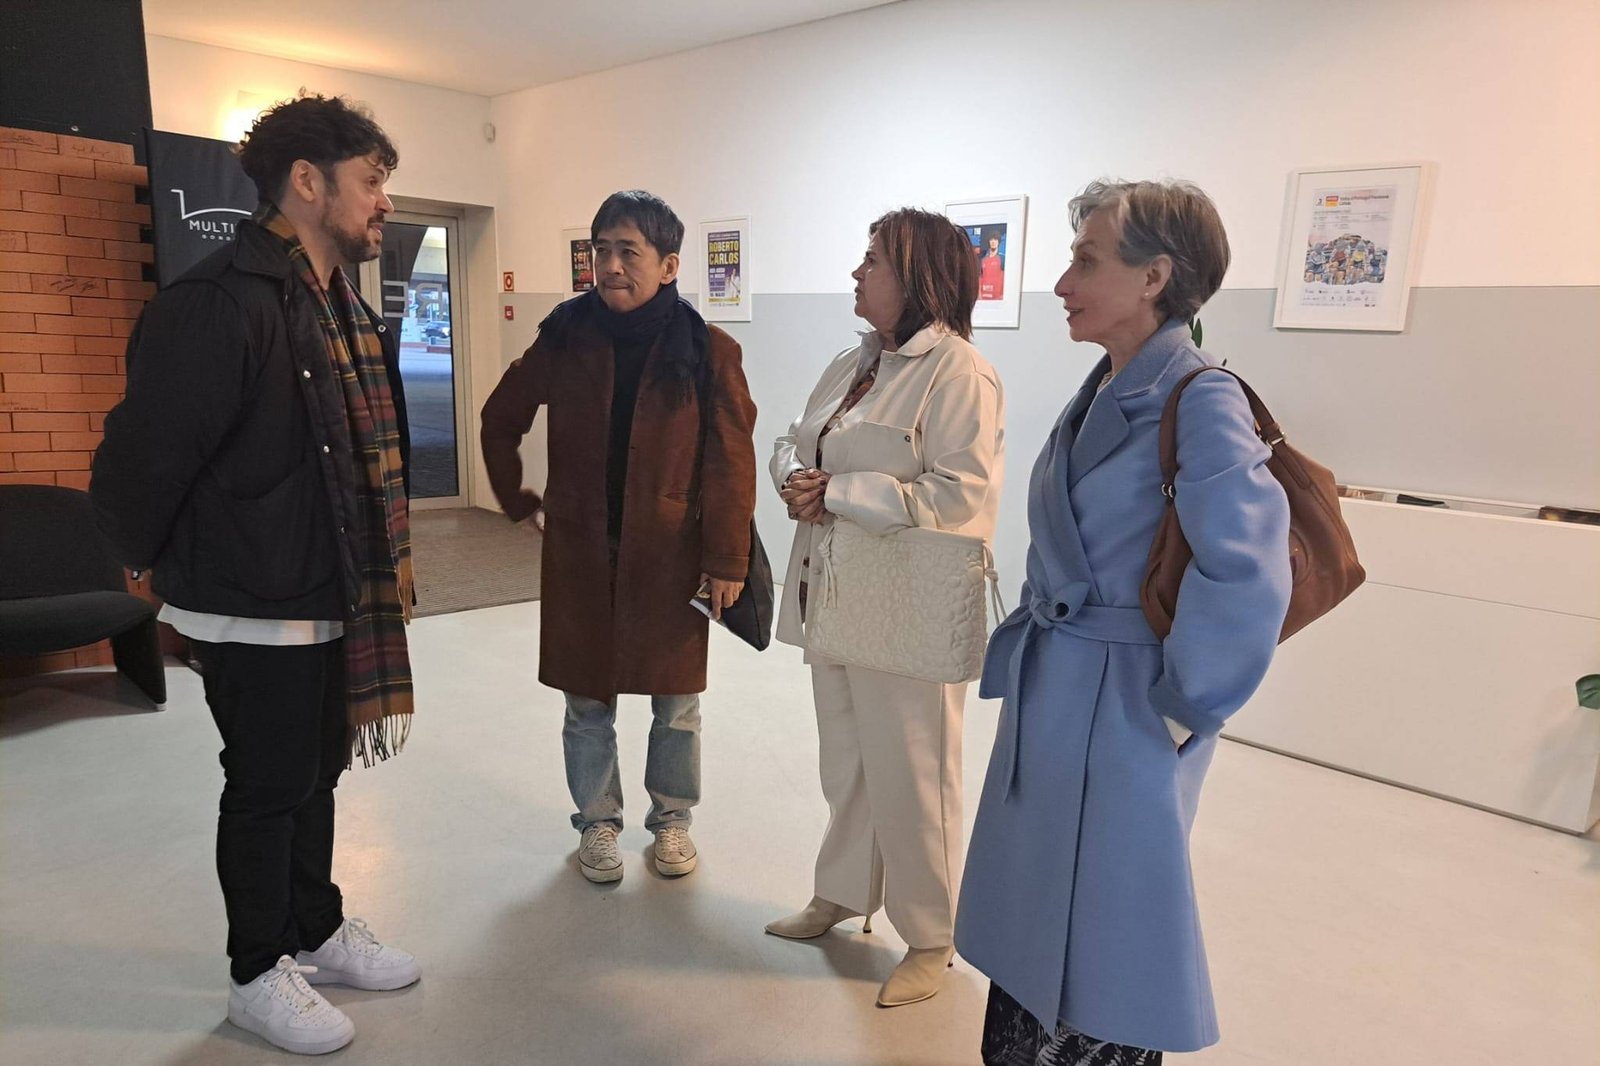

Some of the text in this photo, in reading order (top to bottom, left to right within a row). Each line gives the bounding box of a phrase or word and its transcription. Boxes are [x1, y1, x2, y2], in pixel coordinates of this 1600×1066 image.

[189, 220, 236, 234] MULTI
[709, 240, 739, 252] ROBERTO
[709, 252, 739, 265] CARLOS
